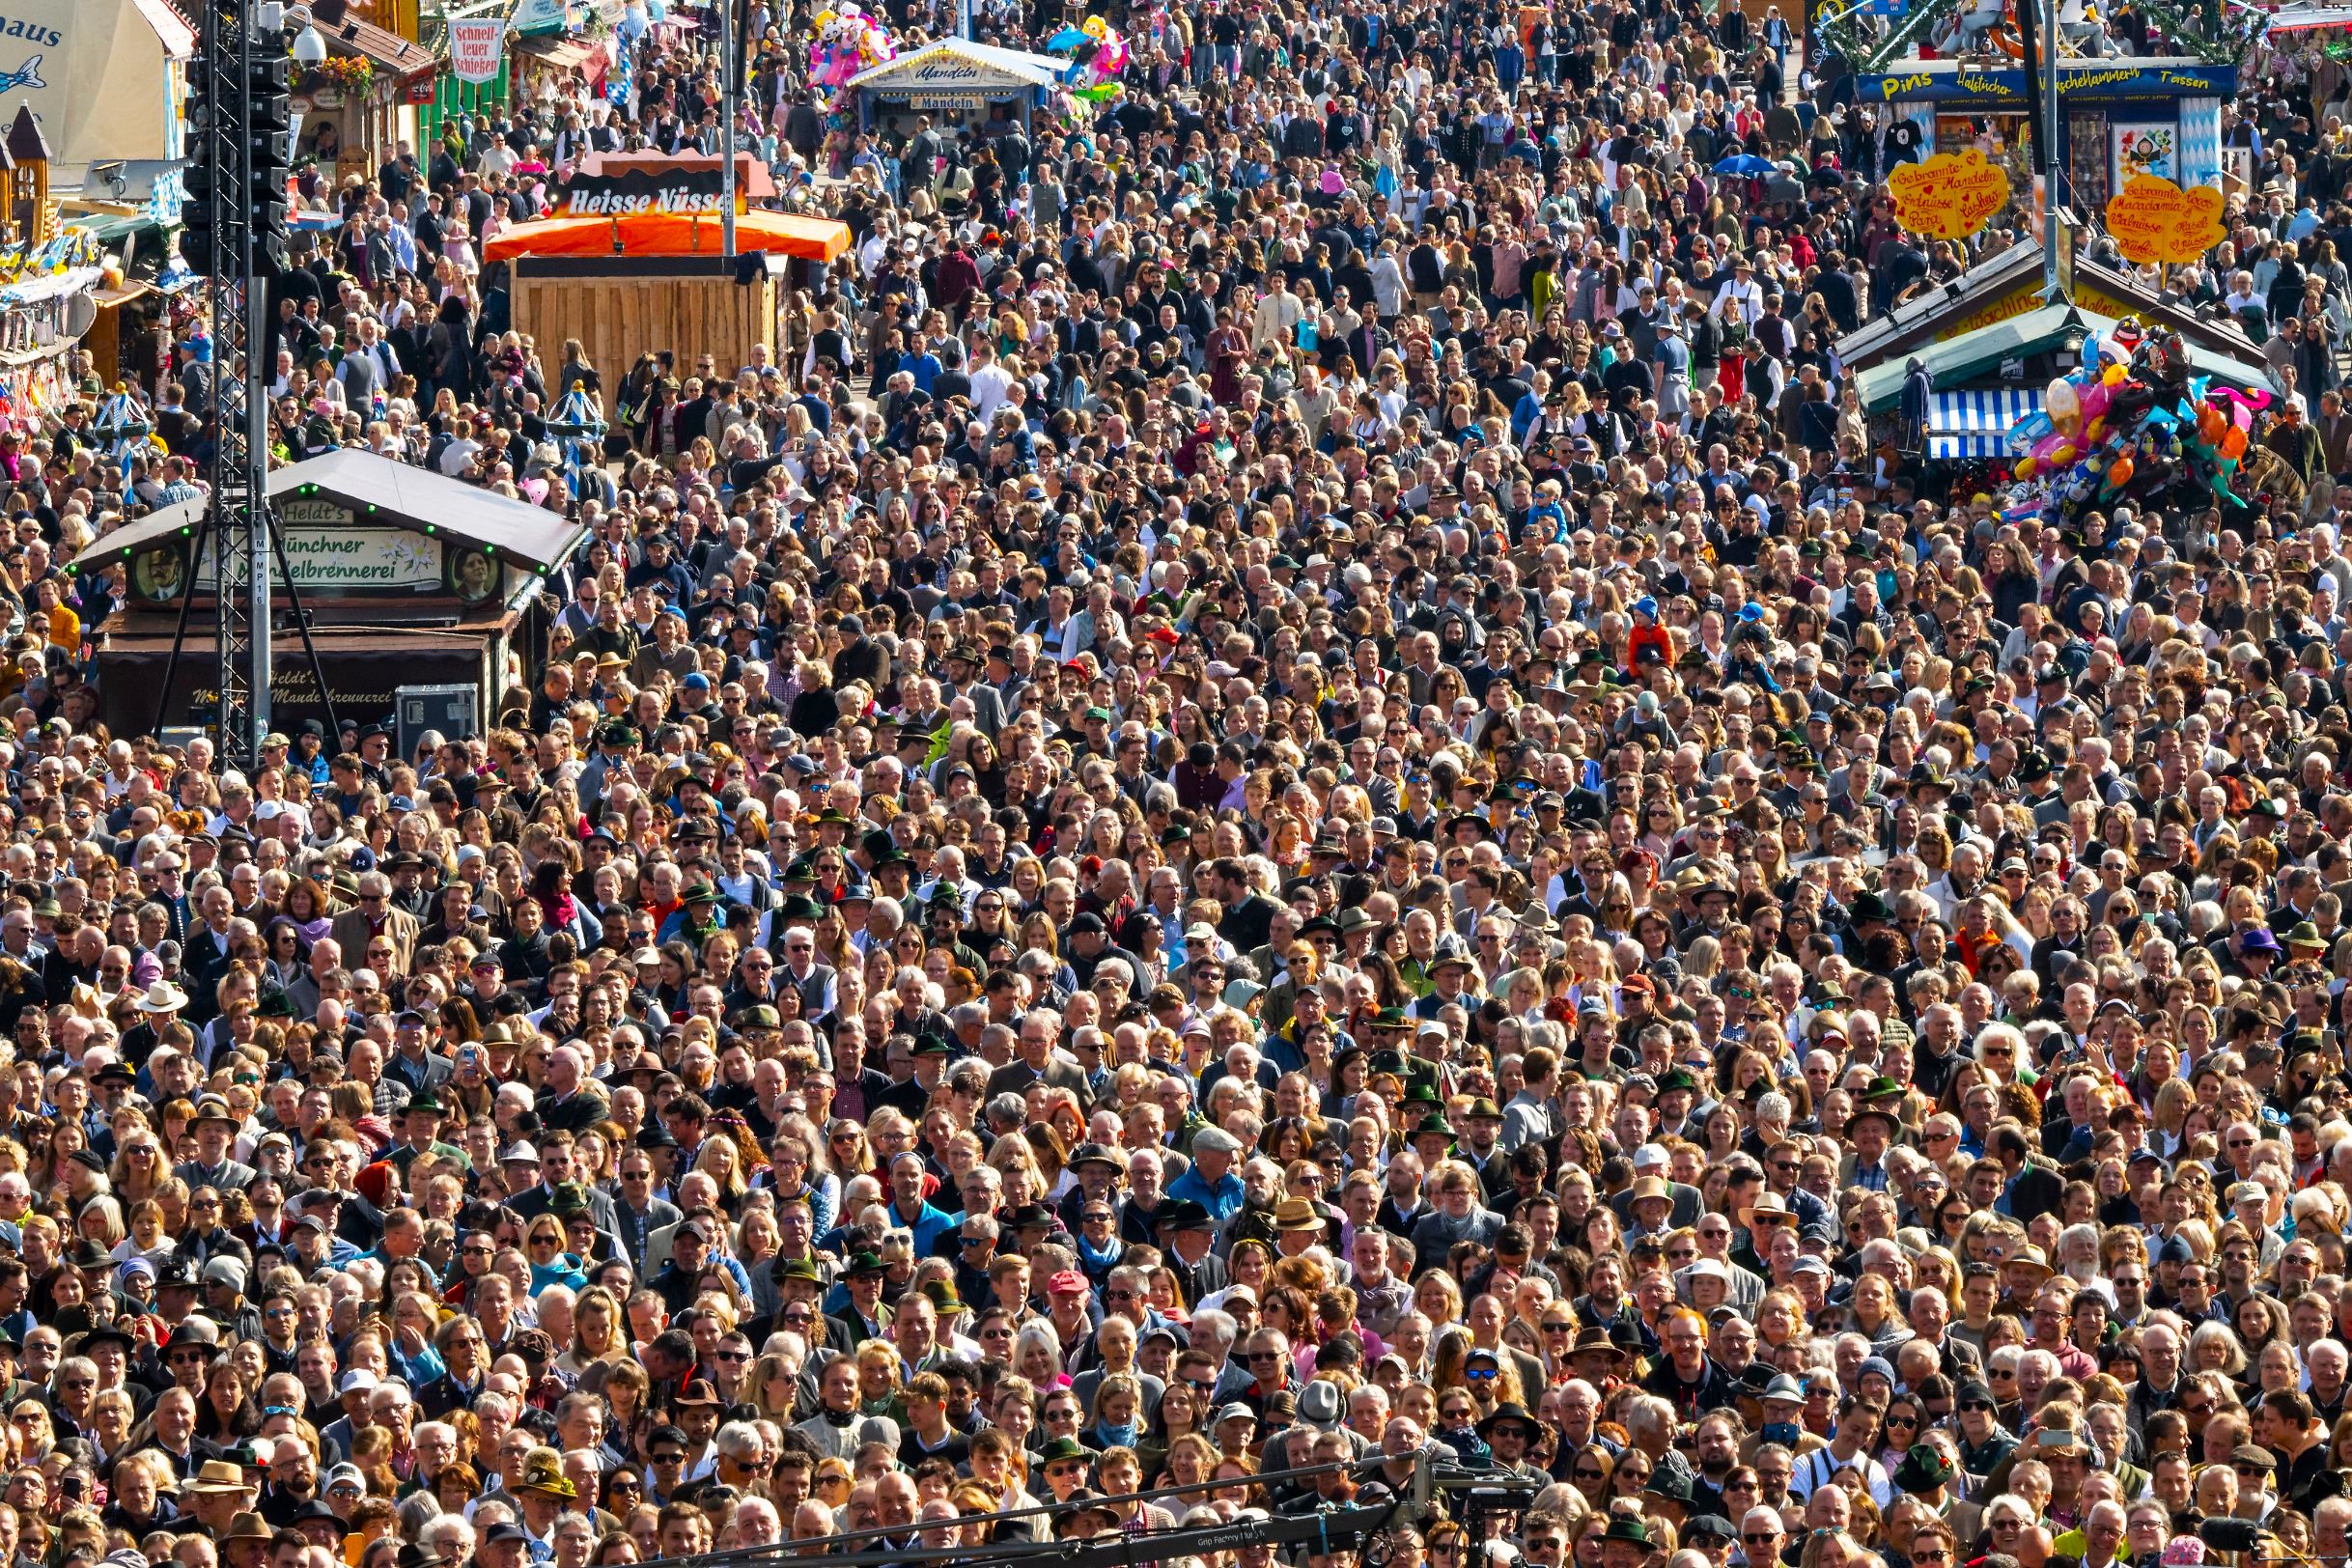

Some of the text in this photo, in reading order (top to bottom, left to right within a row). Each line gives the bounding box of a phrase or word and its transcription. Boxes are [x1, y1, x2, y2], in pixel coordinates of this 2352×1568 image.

[455, 26, 498, 42] Schnell-
[915, 65, 977, 81] Mandeln
[1883, 70, 1932, 100] Pins
[2161, 70, 2209, 90] Tassen
[922, 98, 973, 108] Mandeln
[1897, 162, 1961, 185] Gebrannte
[1942, 169, 1998, 190] Mandeln
[569, 186, 724, 214] Heisse Nüsse
[2125, 184, 2179, 200] Gebrannte
[1903, 193, 1953, 209] Erdnüsse
[1959, 189, 1999, 218] Cashew
[2114, 198, 2182, 212] Macadamia
[1908, 210, 1939, 227] Para
[2111, 213, 2162, 233] Walnüsse
[285, 500, 346, 519] Heldt's
[271, 688, 392, 703] Mandebrennerei
[1198, 1537, 1213, 1546] Grip
